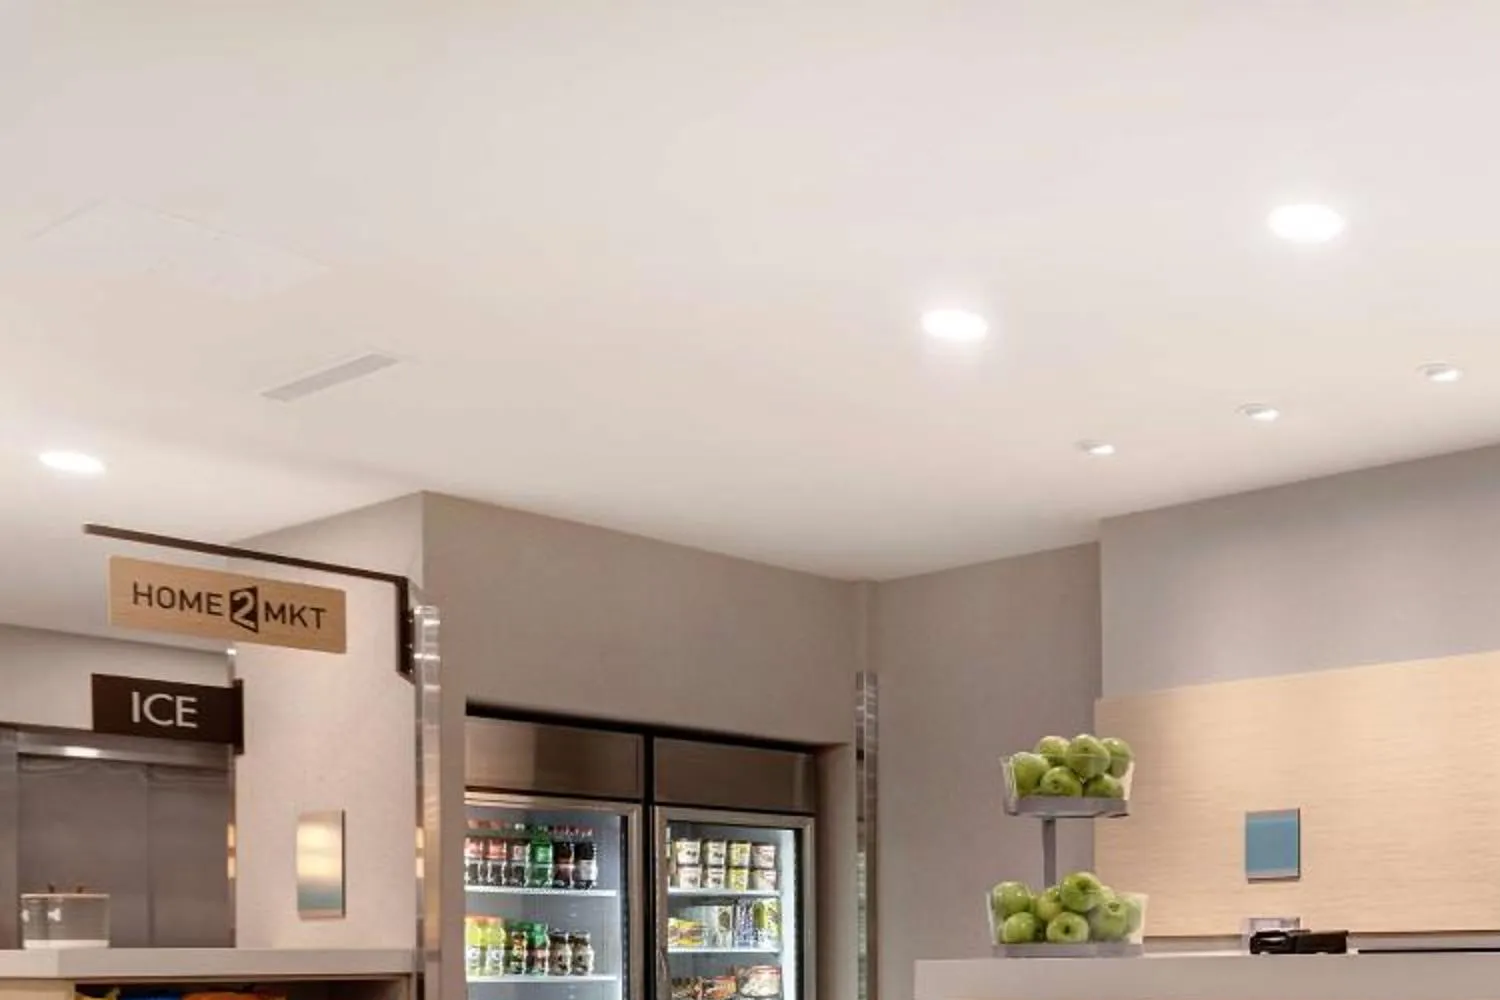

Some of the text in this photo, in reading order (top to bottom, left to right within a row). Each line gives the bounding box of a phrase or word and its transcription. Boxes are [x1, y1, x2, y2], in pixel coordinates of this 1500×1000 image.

[132, 581, 224, 617] HOME
[264, 601, 327, 630] MKT
[131, 690, 198, 728] ICE
